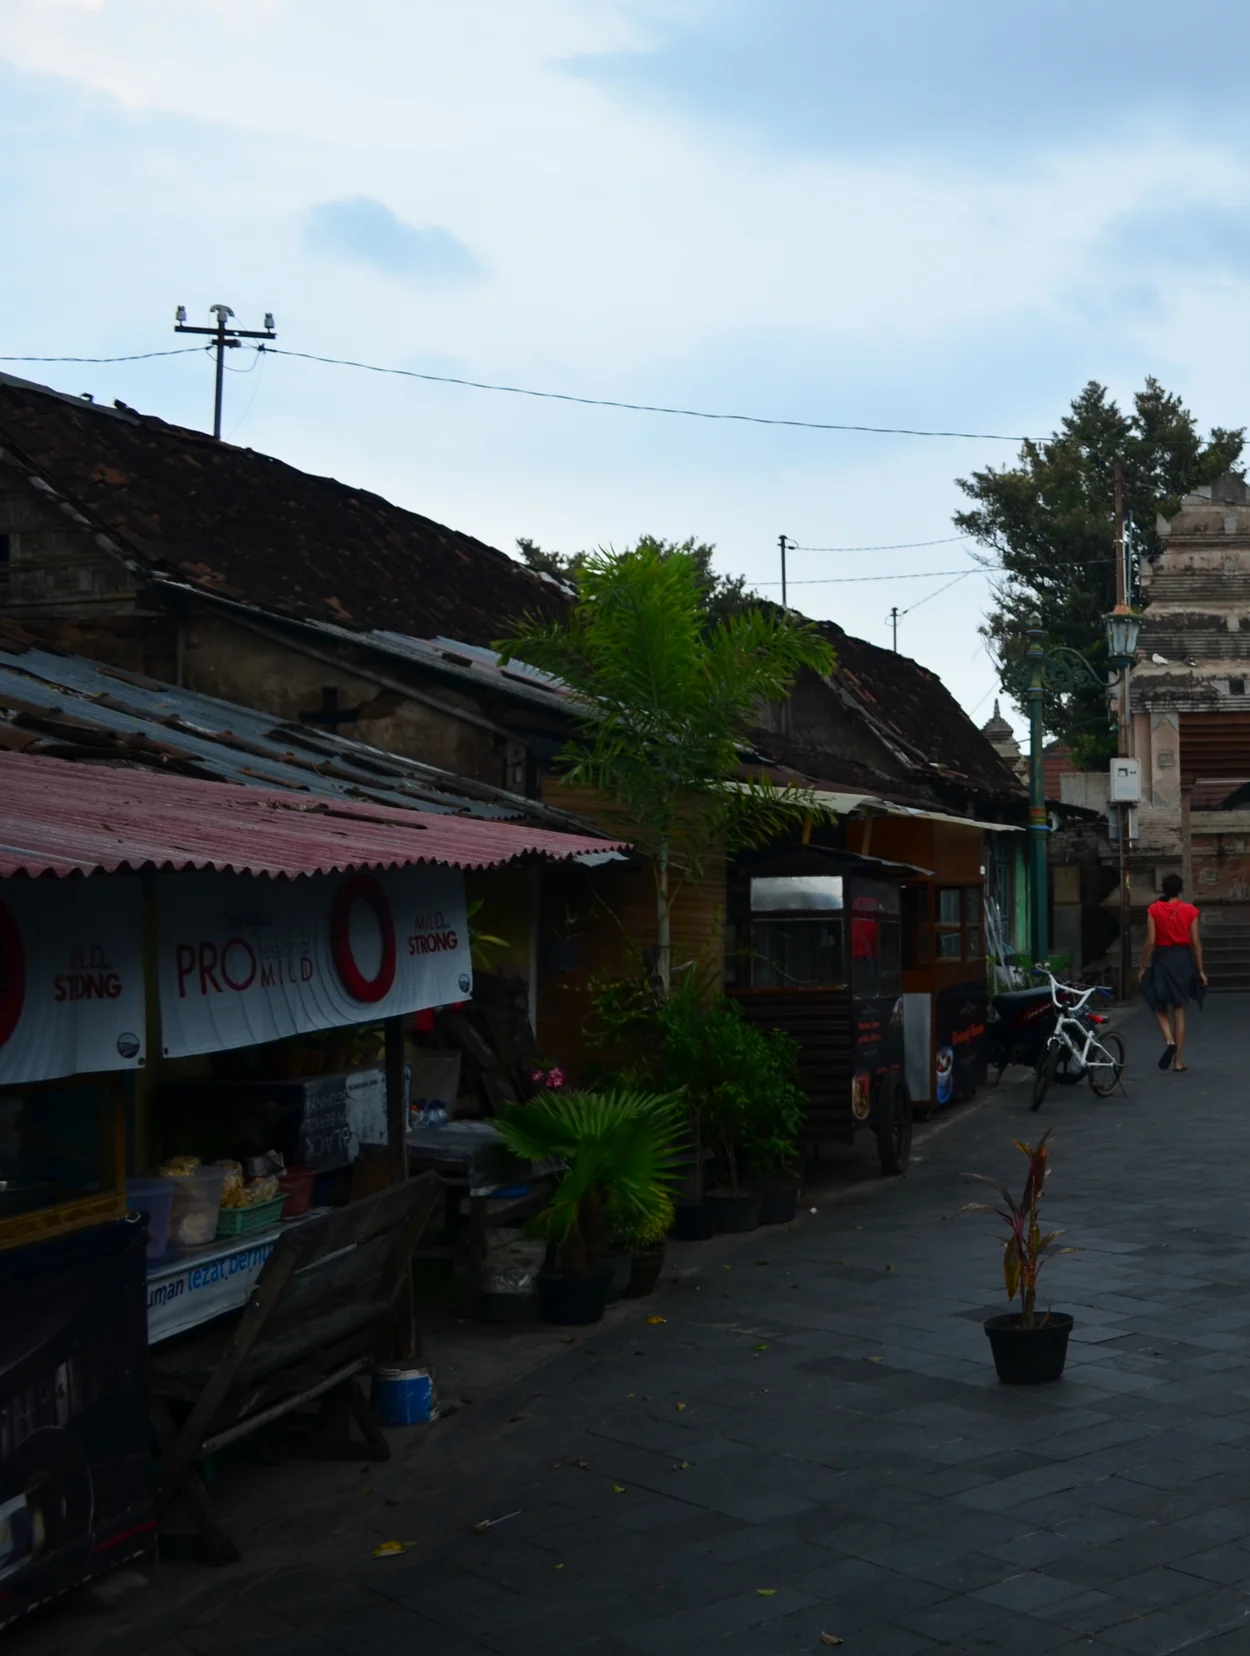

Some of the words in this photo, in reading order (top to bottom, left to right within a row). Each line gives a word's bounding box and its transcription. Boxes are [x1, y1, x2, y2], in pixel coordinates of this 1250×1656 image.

[414, 909, 444, 933] MILD
[407, 930, 458, 956] STRONG
[176, 937, 257, 998] PRO
[261, 956, 313, 988] MILD
[187, 1260, 225, 1291] lezat
